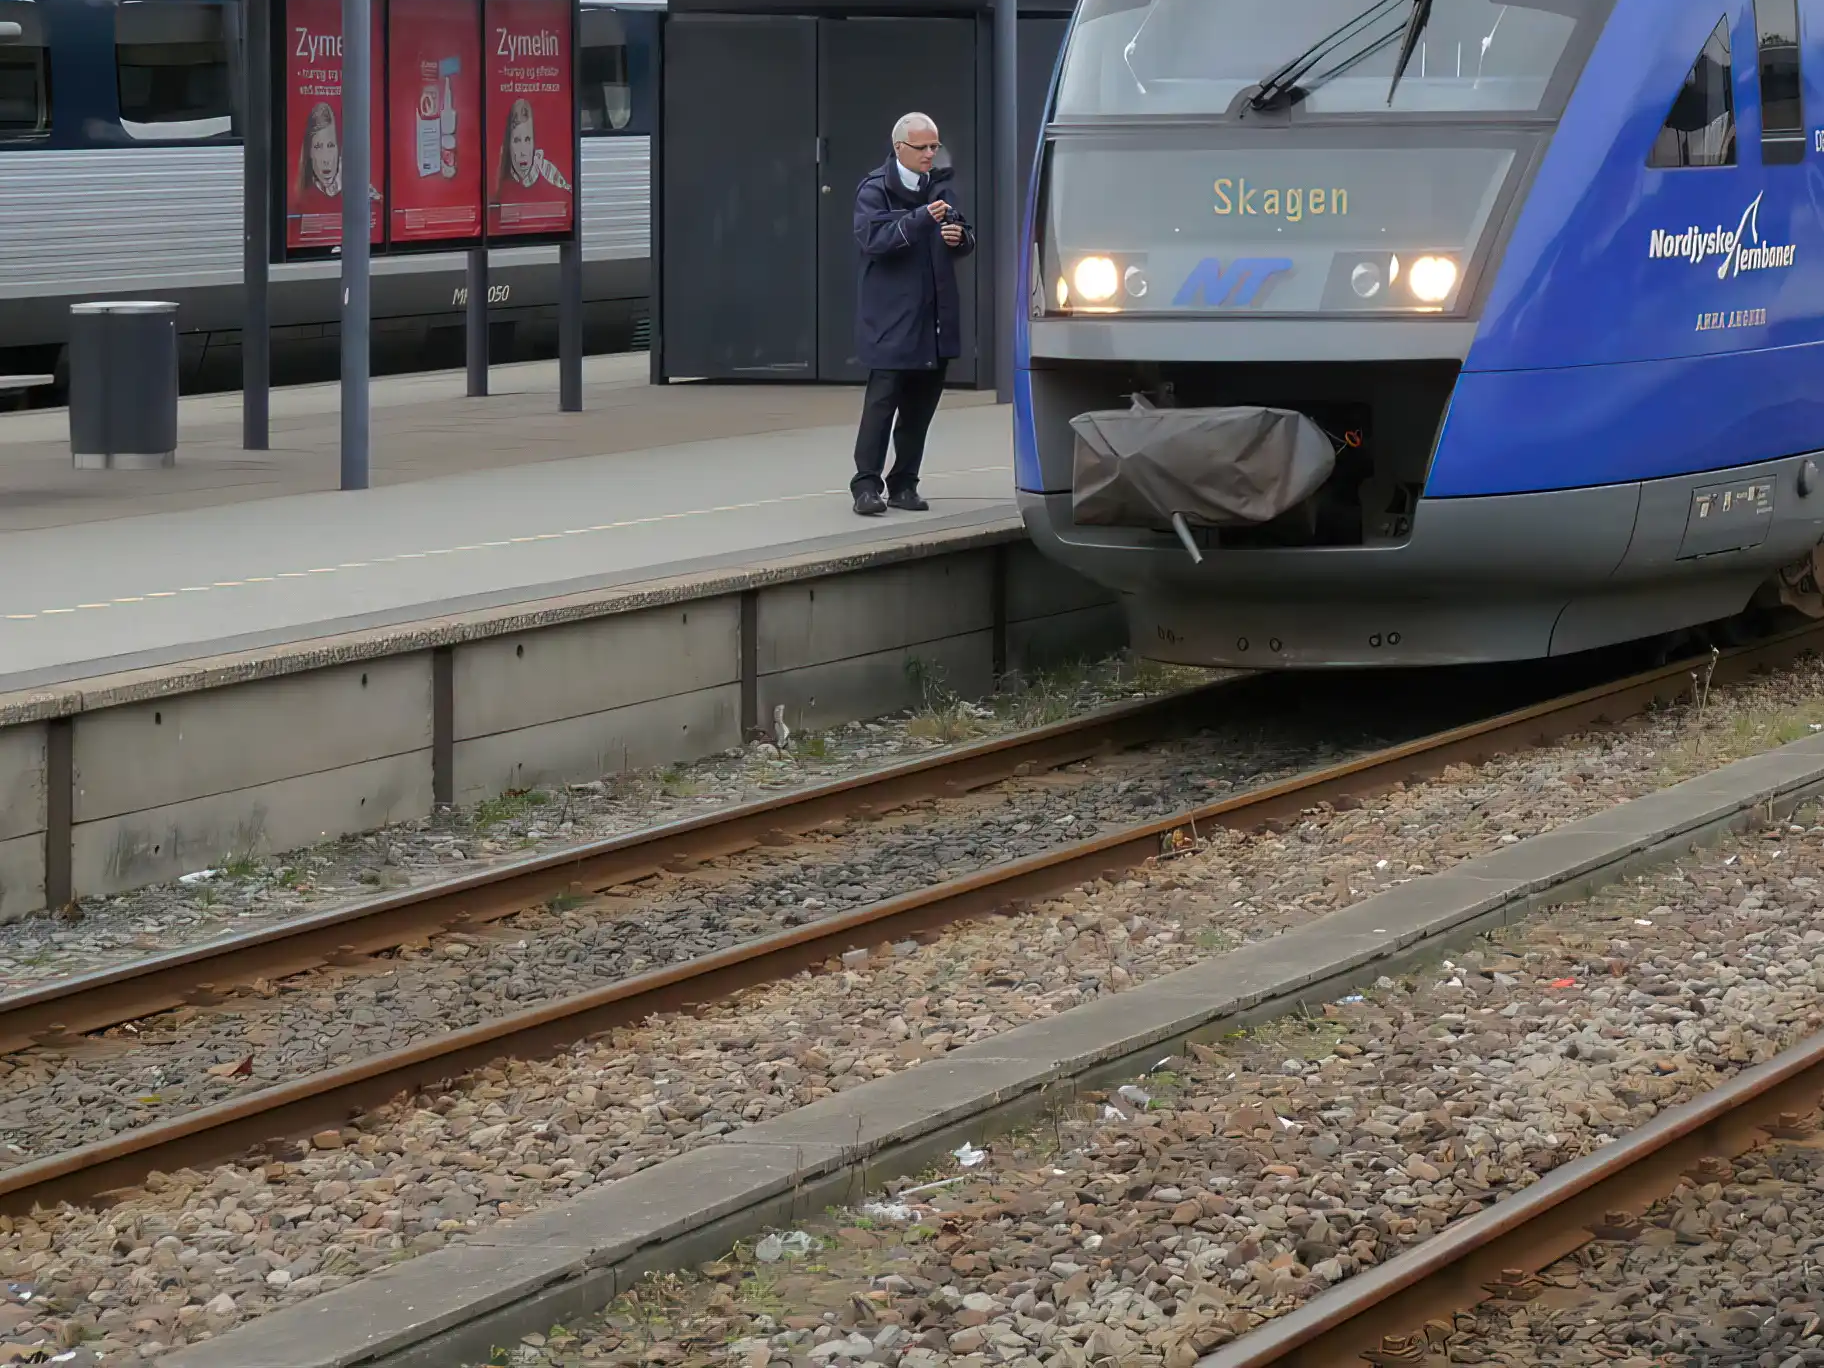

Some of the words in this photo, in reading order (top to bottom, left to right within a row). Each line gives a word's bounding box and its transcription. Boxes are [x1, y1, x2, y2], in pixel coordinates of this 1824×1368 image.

[295, 26, 343, 64] Zyme
[496, 26, 559, 62] Zymelin
[1213, 177, 1348, 223] Skagen
[1648, 224, 1734, 264] Nordjyske
[1171, 257, 1294, 307] NT
